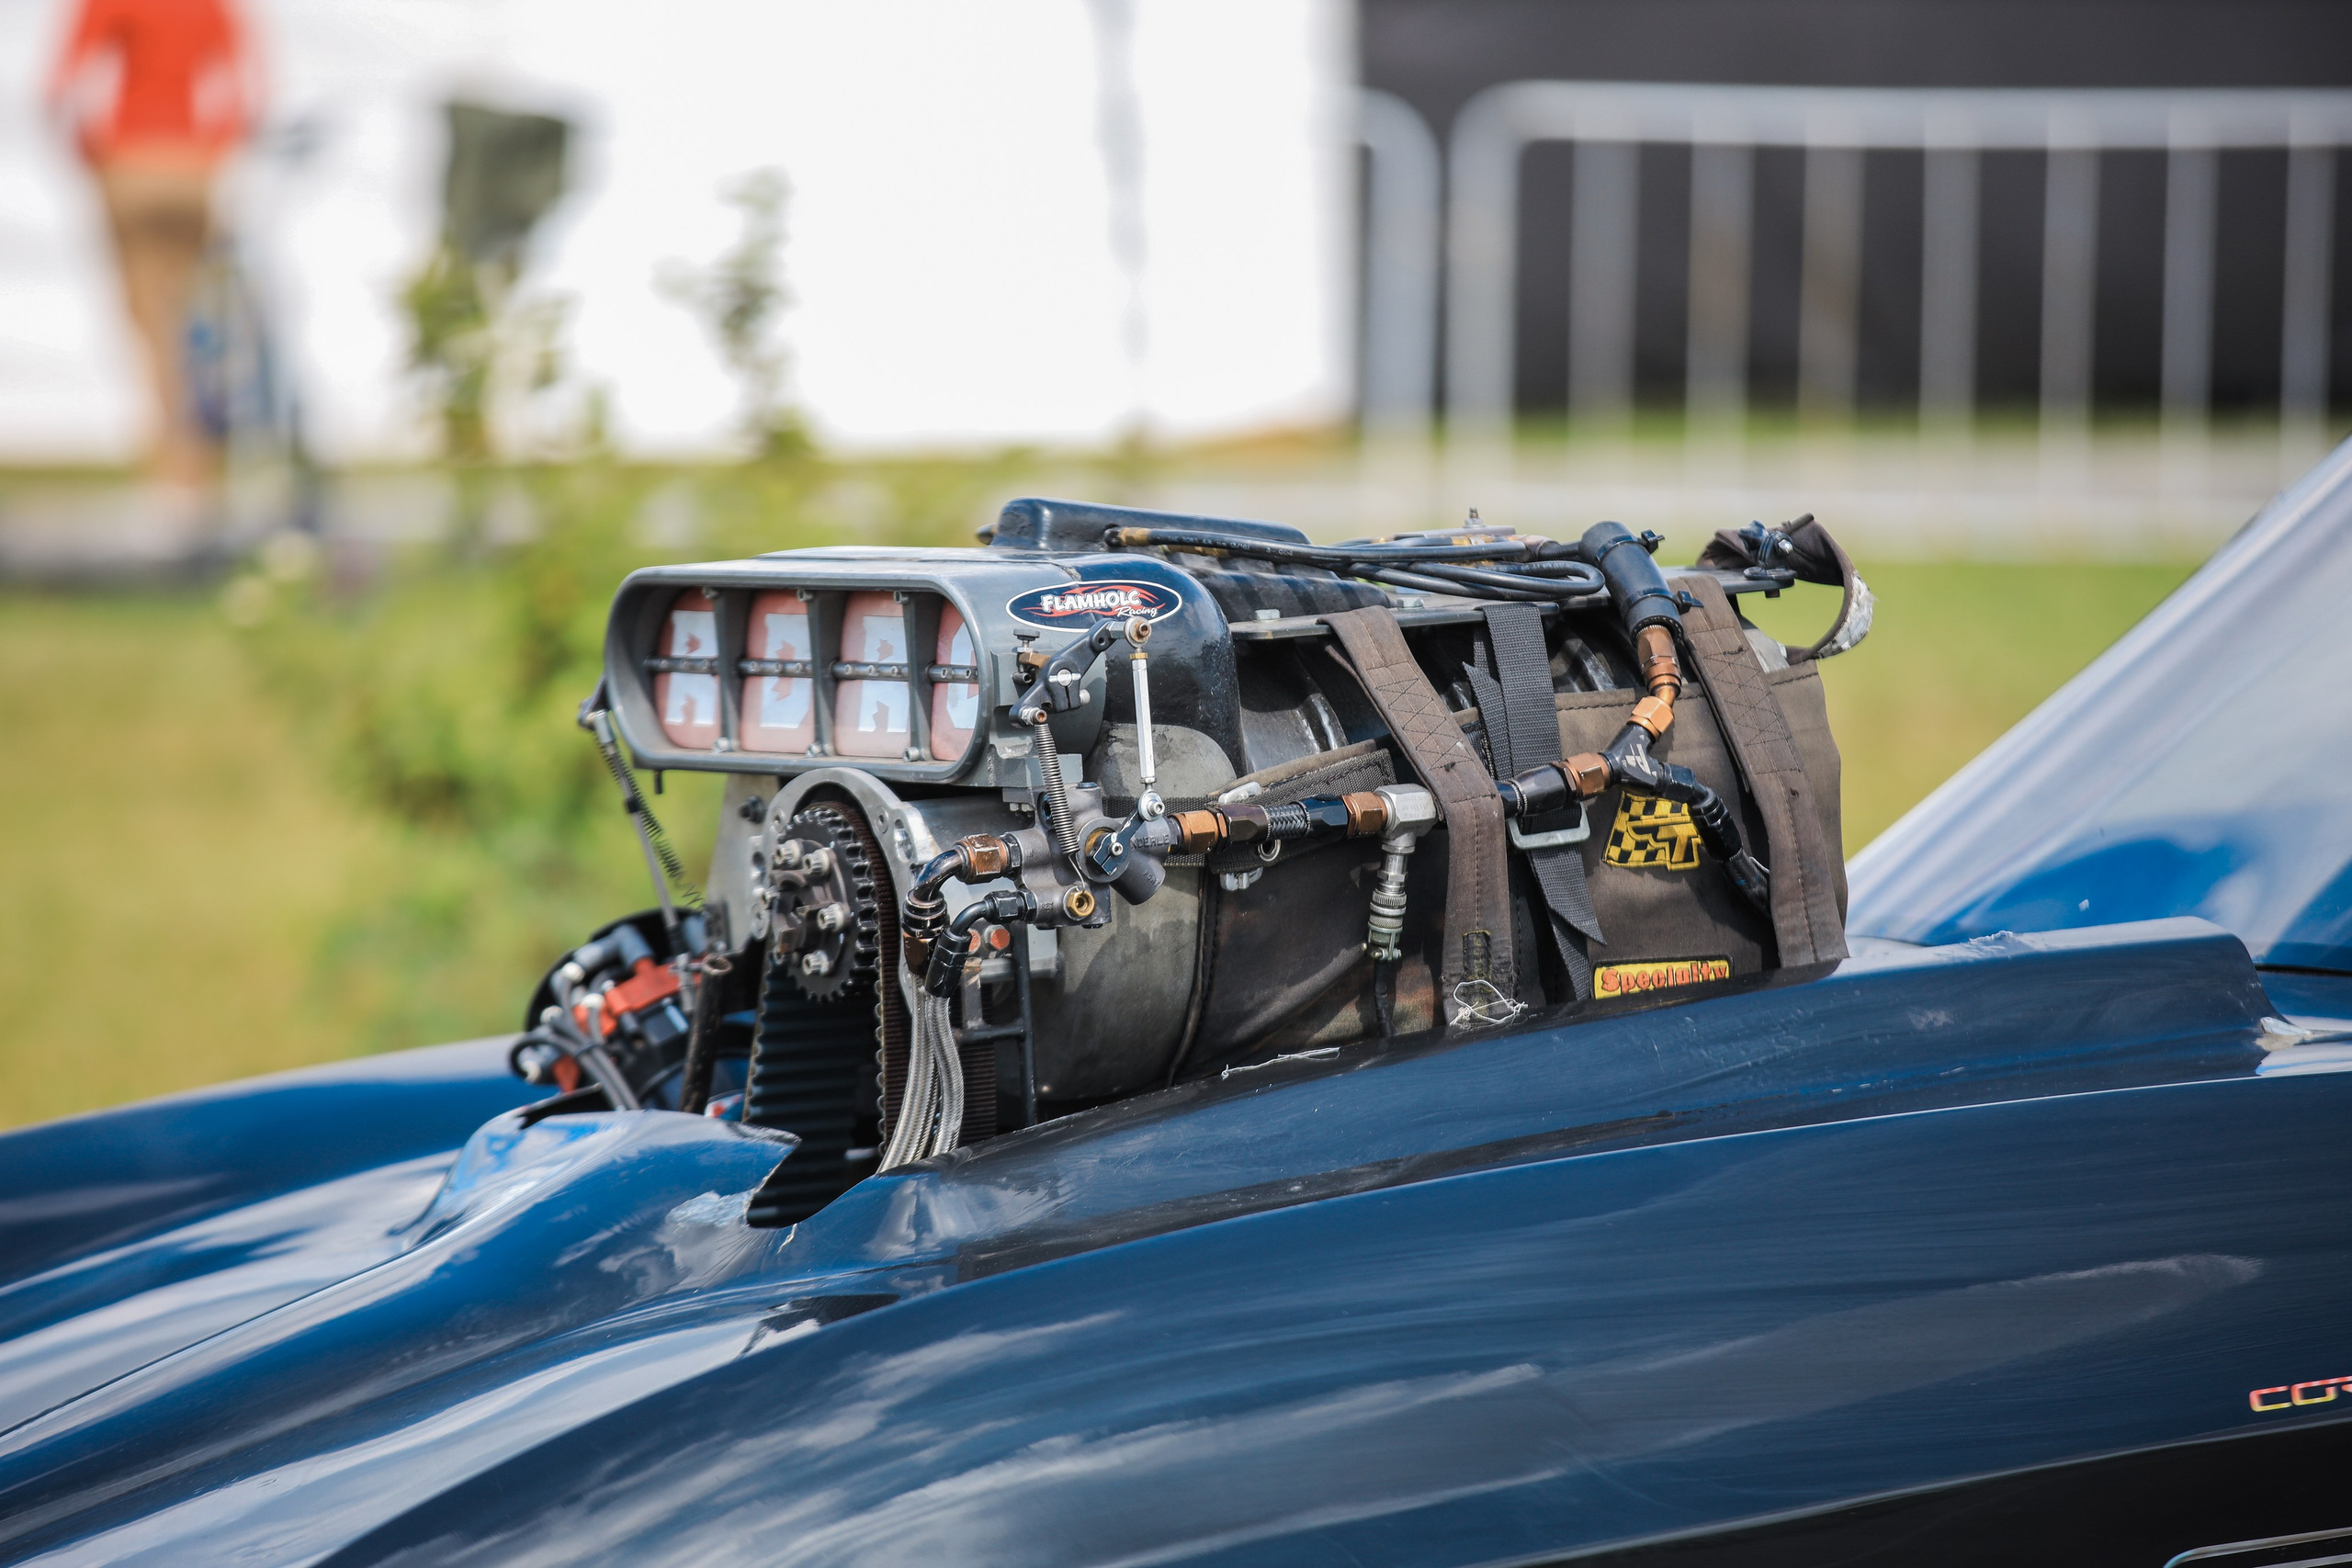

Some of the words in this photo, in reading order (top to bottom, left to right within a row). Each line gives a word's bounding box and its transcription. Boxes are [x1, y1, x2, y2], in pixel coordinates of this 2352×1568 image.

[1040, 590, 1142, 613] FLAMHOLC
[1114, 606, 1158, 618] Racing
[1129, 834, 1170, 851] NDERLE
[1601, 962, 1727, 993] Specialty
